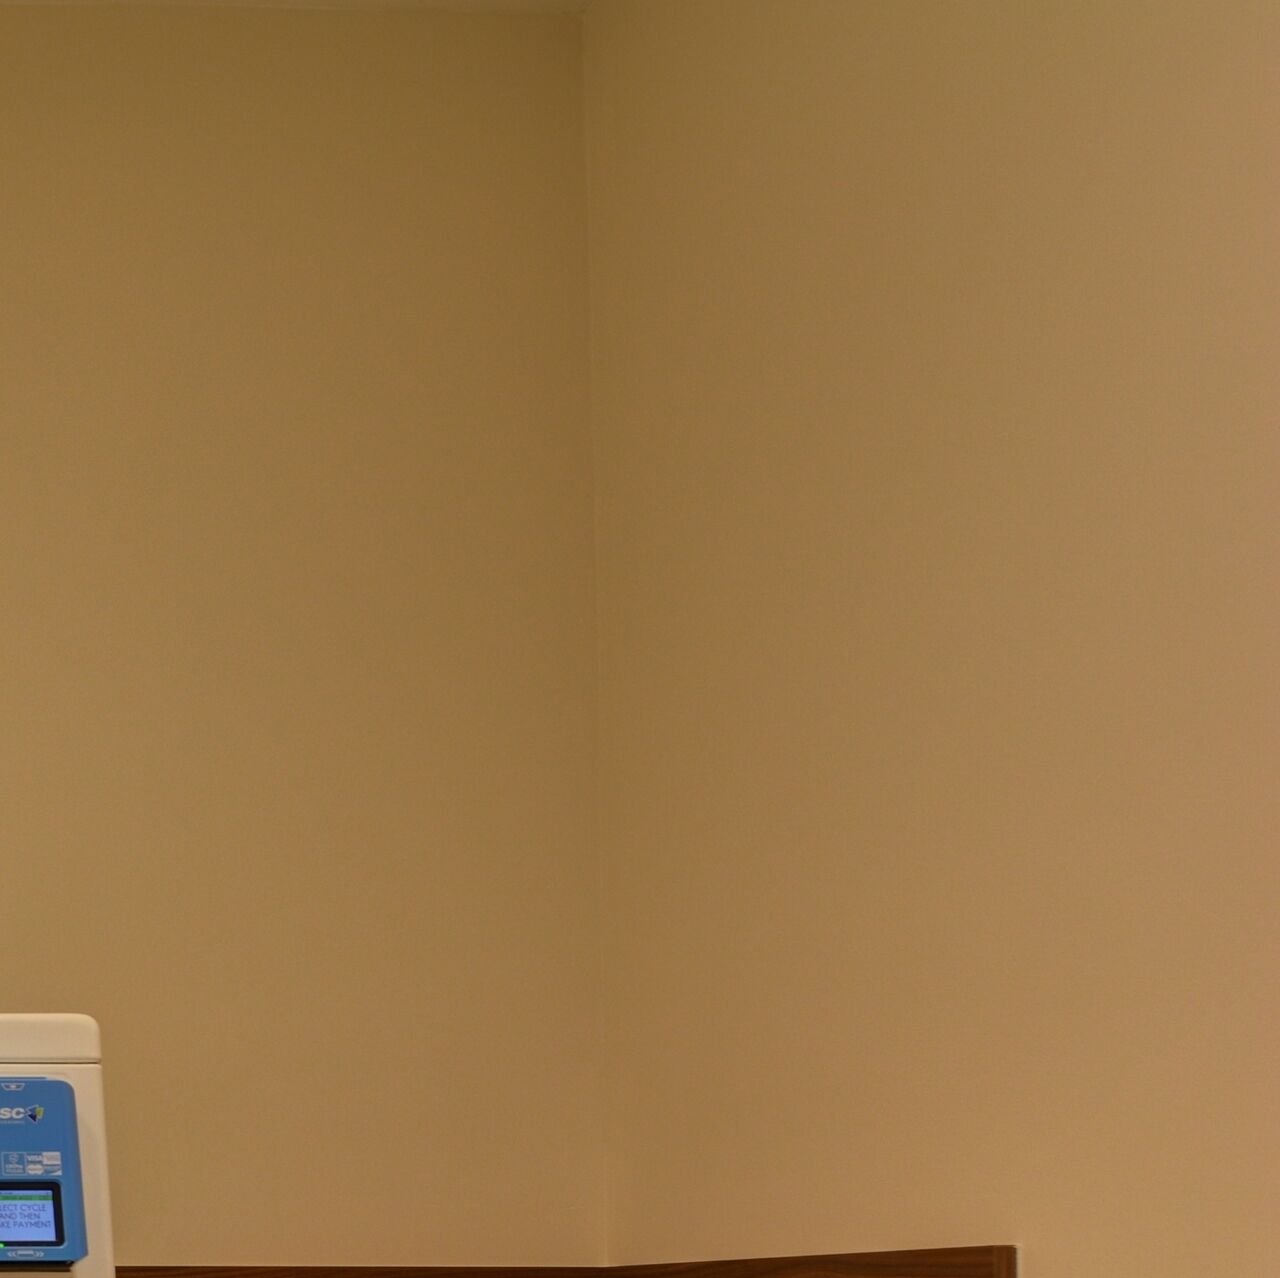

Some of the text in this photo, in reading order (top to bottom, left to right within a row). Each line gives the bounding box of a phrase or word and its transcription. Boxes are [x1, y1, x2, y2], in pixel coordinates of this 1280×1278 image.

[19, 1204, 47, 1212] CYCLE
[0, 1212, 41, 1220] AND THEN
[13, 1221, 52, 1229] PAYMENT
